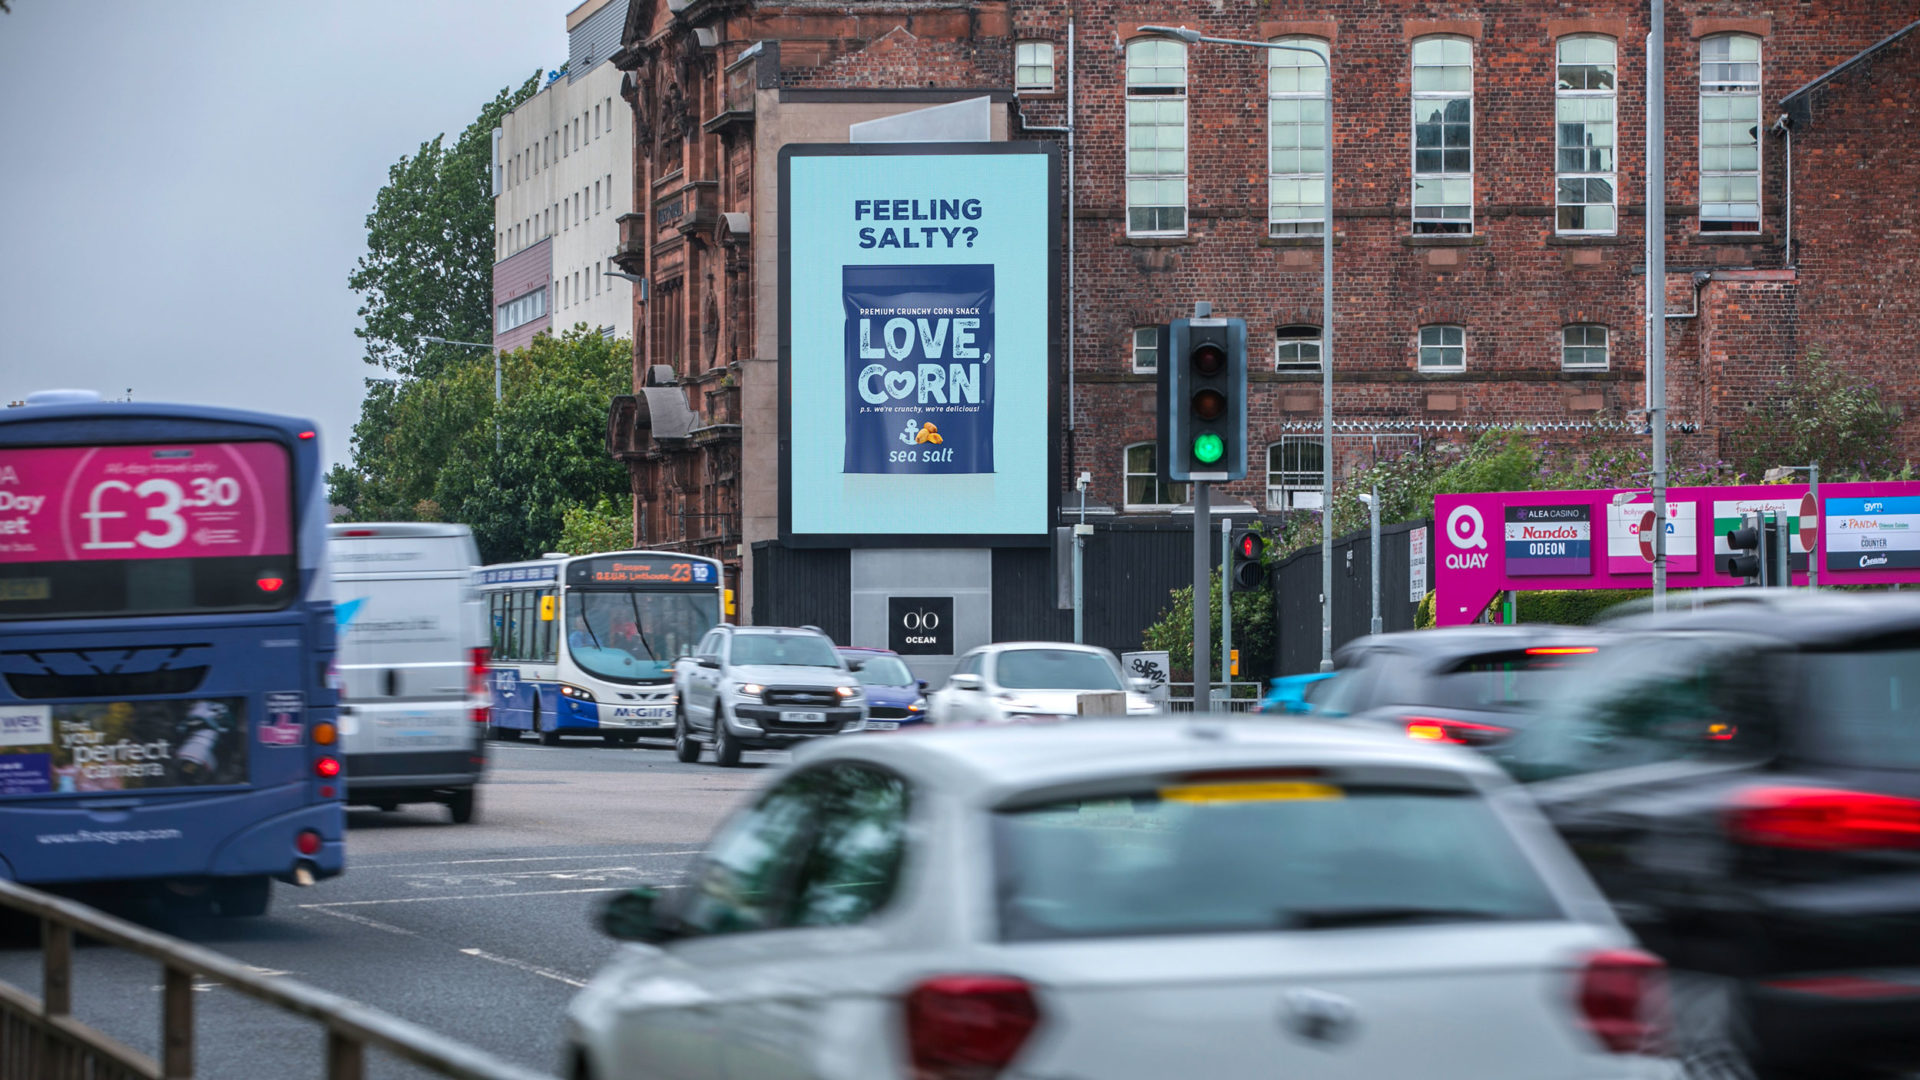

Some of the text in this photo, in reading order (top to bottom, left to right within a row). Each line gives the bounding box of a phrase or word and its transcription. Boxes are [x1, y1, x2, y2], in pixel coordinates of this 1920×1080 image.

[855, 199, 982, 221] FEELING
[859, 226, 979, 249] SALTY?
[860, 307, 980, 316] PREMIUM CRUNCHY CORN SNACK
[859, 317, 992, 364] LOVE,
[945, 405, 980, 413] delicious!
[889, 447, 954, 463] sea salt
[1528, 509, 1579, 518] ALEA CASINO
[1864, 502, 1883, 512] gym
[1848, 519, 1878, 529] PANDA
[1522, 526, 1578, 539] Nando's
[1529, 542, 1566, 555] ODEON
[1861, 538, 1887, 548] COUNTER
[1445, 553, 1489, 569] QUAY
[671, 563, 692, 582] 23
[614, 707, 673, 718] McGill's
[73, 738, 170, 768] perfect
[82, 762, 165, 779] camera
